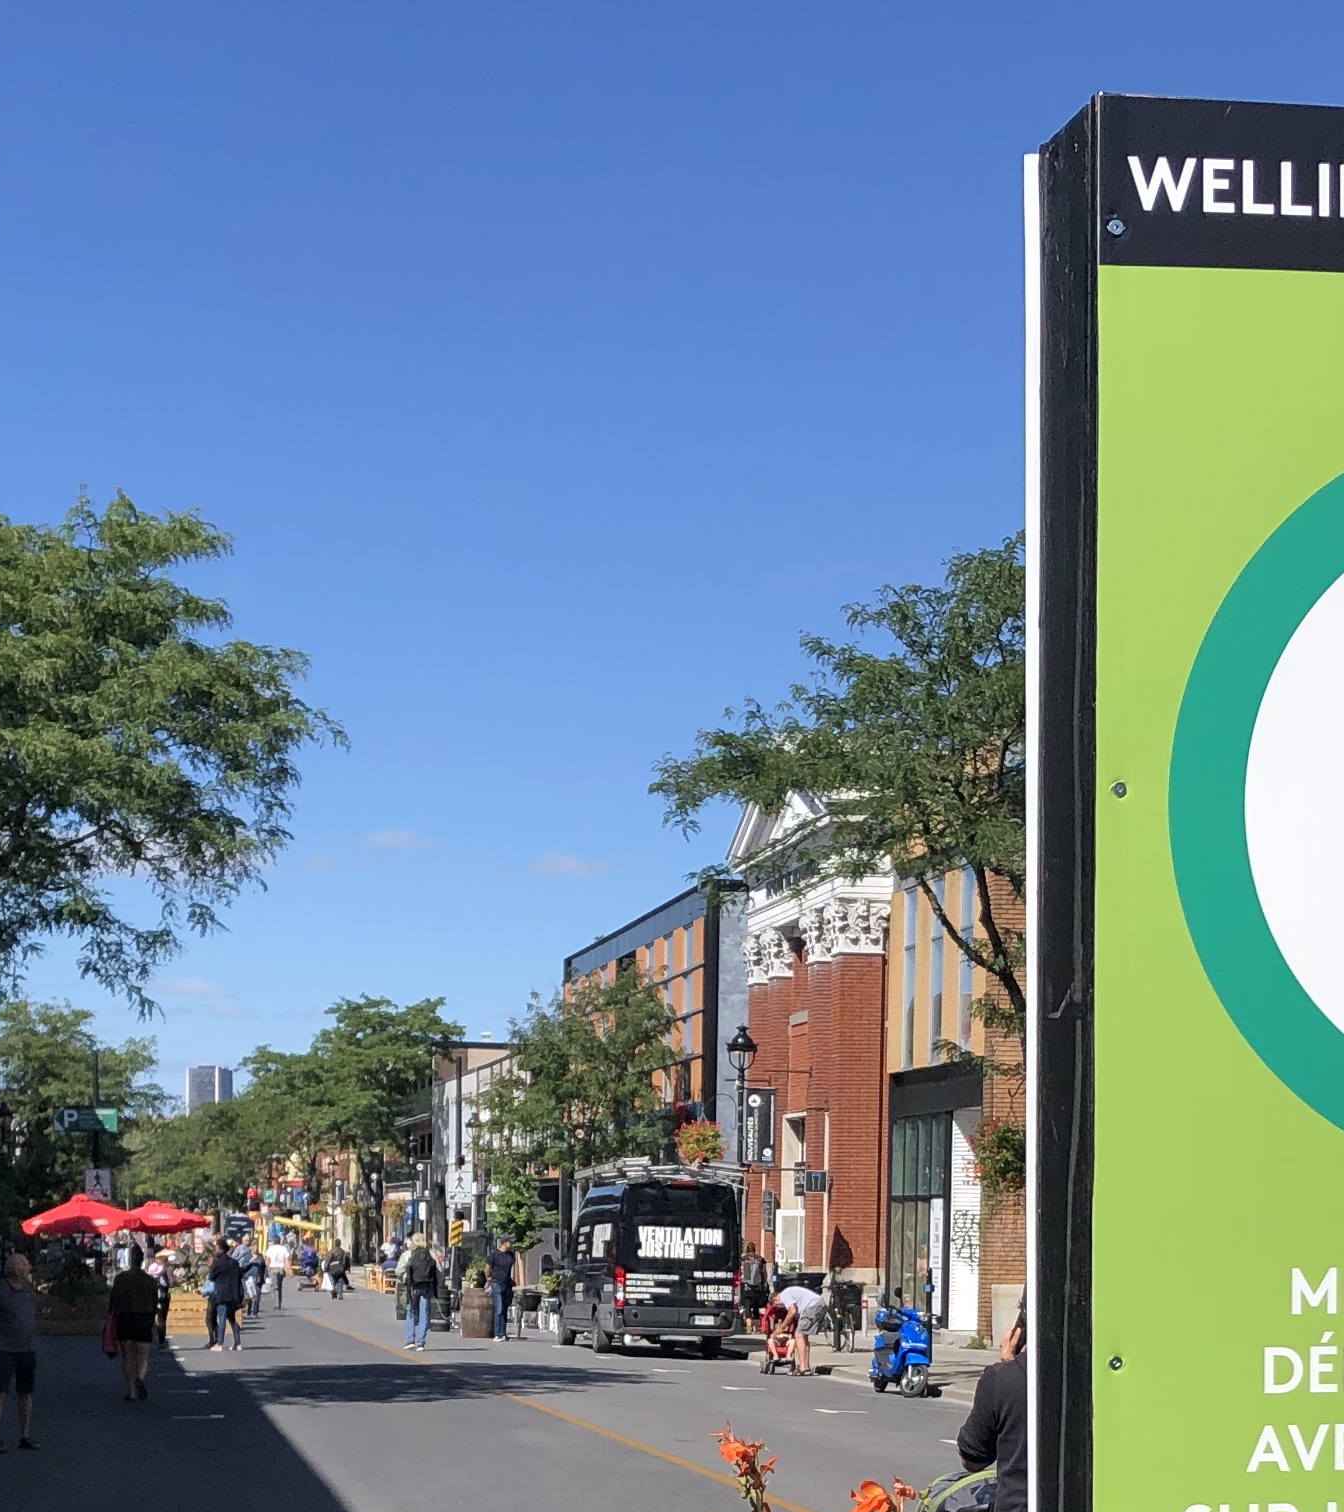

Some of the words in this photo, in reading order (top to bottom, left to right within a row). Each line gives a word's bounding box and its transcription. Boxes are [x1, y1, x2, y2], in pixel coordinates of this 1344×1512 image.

[64, 1109, 78, 1128] P
[638, 1226, 724, 1247] VENTILATION
[637, 1240, 685, 1259] JUSTIN
